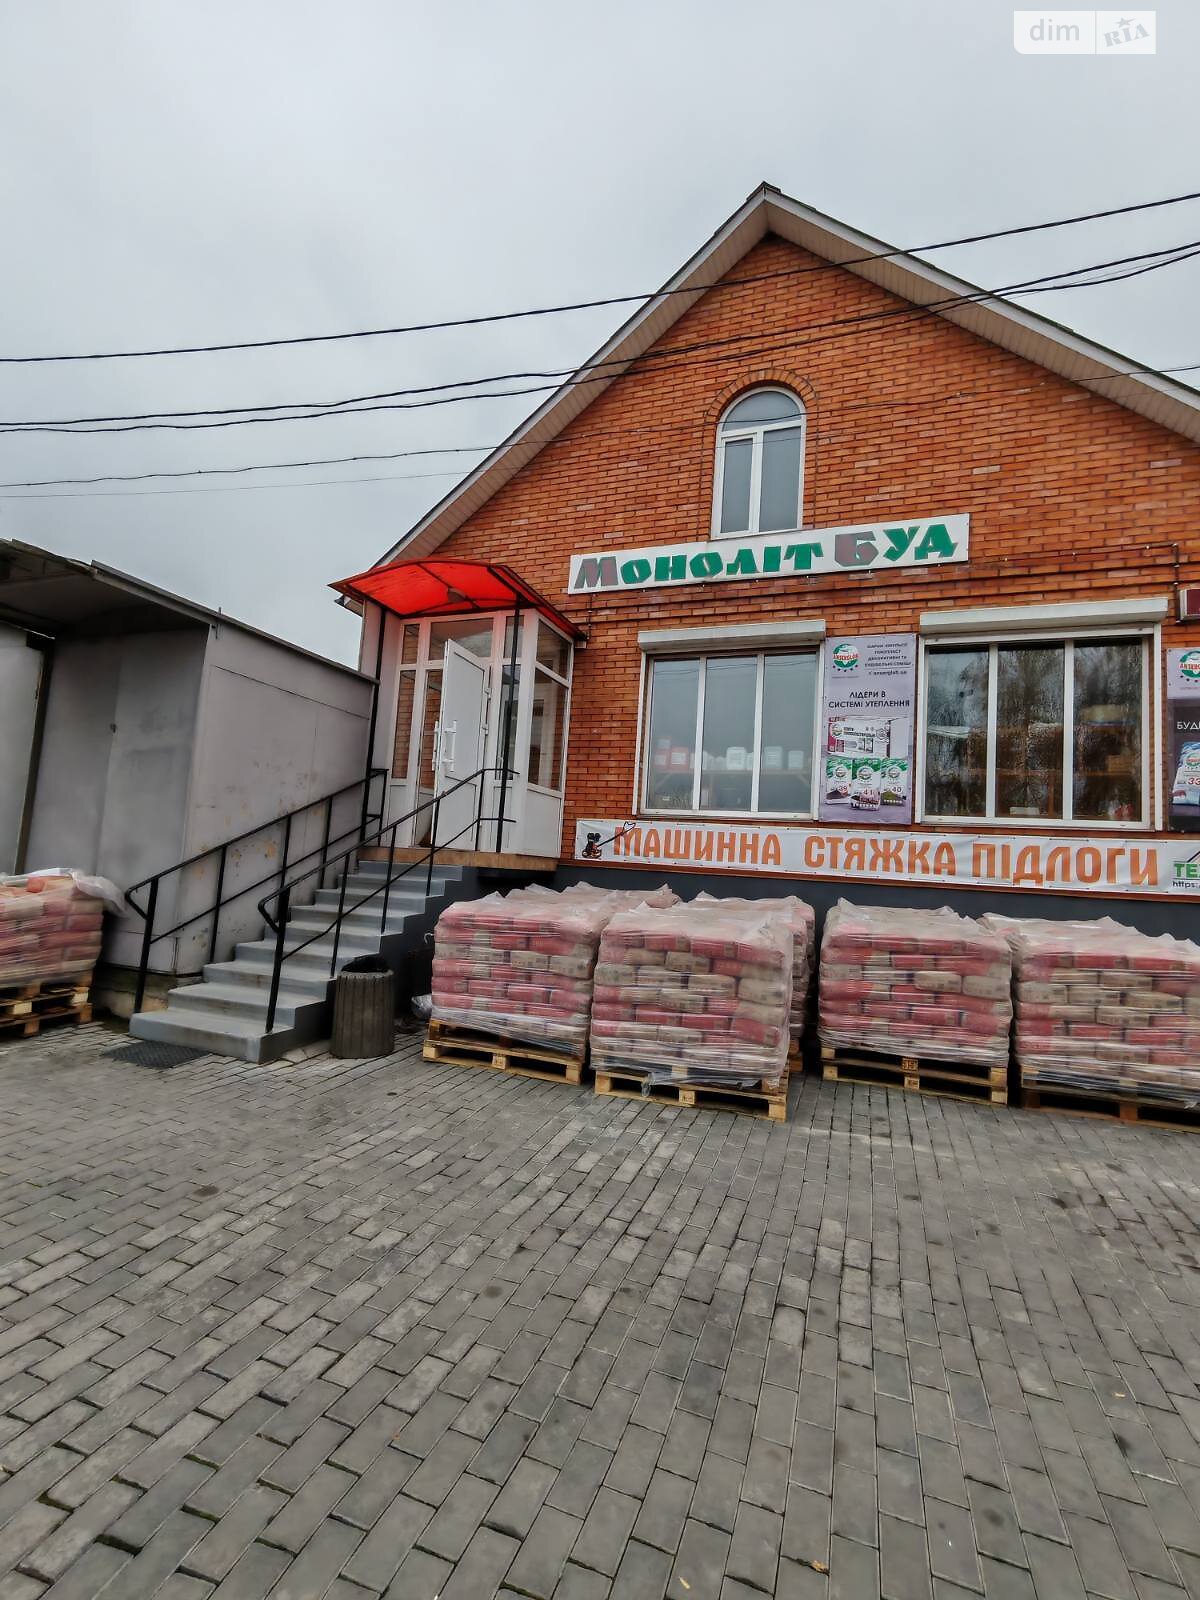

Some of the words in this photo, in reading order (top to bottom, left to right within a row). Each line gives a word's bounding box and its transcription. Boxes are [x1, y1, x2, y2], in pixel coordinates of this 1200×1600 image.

[828, 701, 863, 709] СИСТЕМІ
[865, 699, 910, 708] УТЕПЛЕННЯ
[613, 826, 781, 866] МАШИННА
[803, 835, 957, 876] СТЯЖКА
[971, 842, 1159, 887] ПІДЛОГИ
